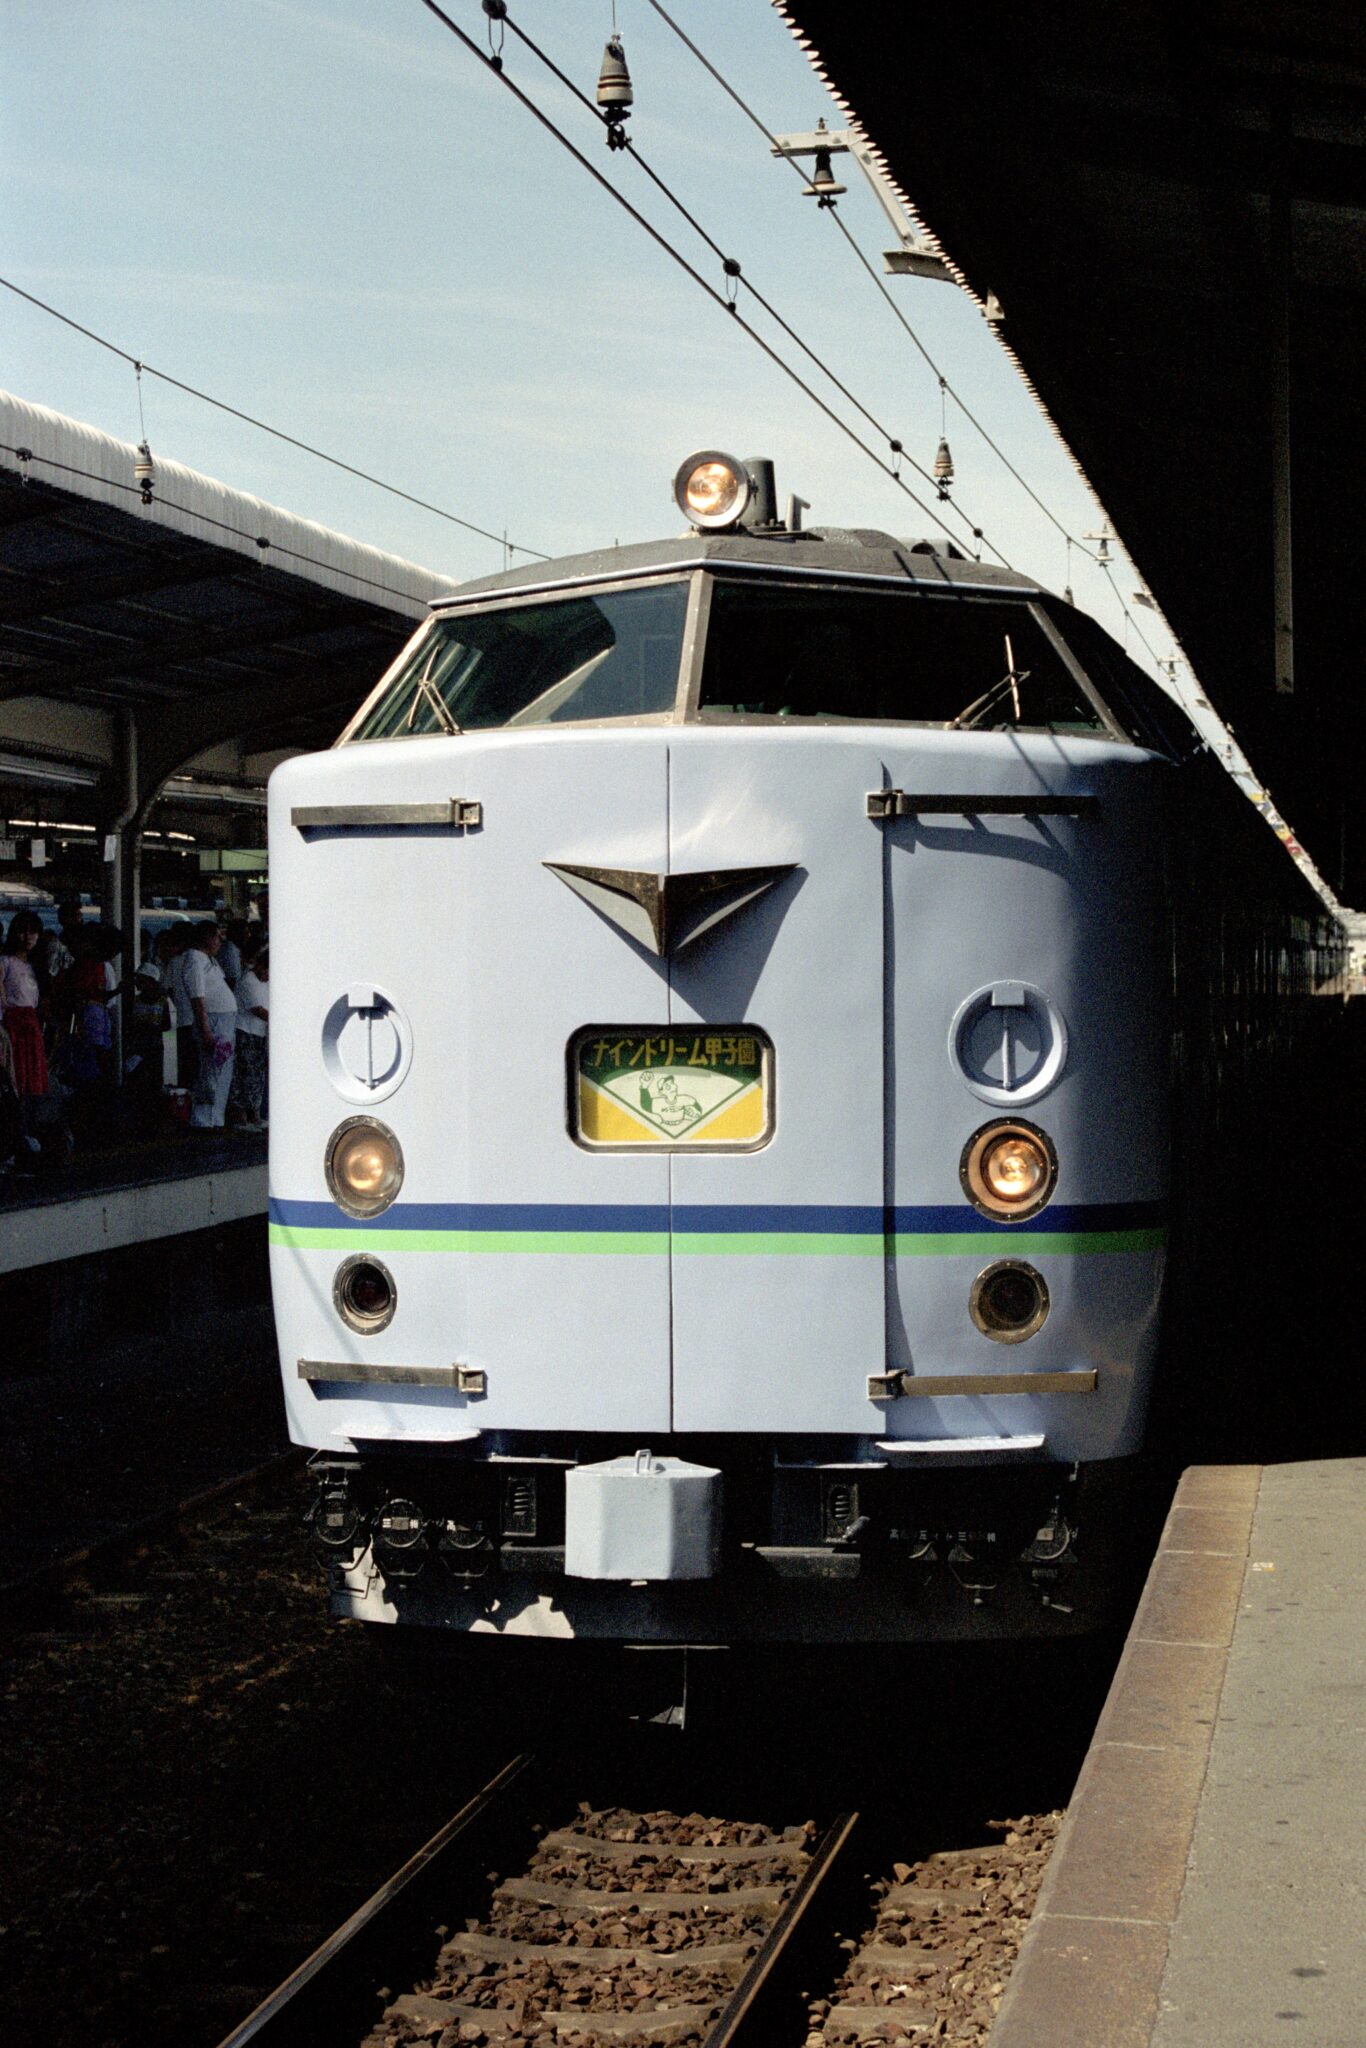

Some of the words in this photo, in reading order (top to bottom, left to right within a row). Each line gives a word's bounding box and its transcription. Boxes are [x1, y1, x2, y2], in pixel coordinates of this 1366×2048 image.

[593, 1035, 756, 1067] ナインドリーム甲子園
